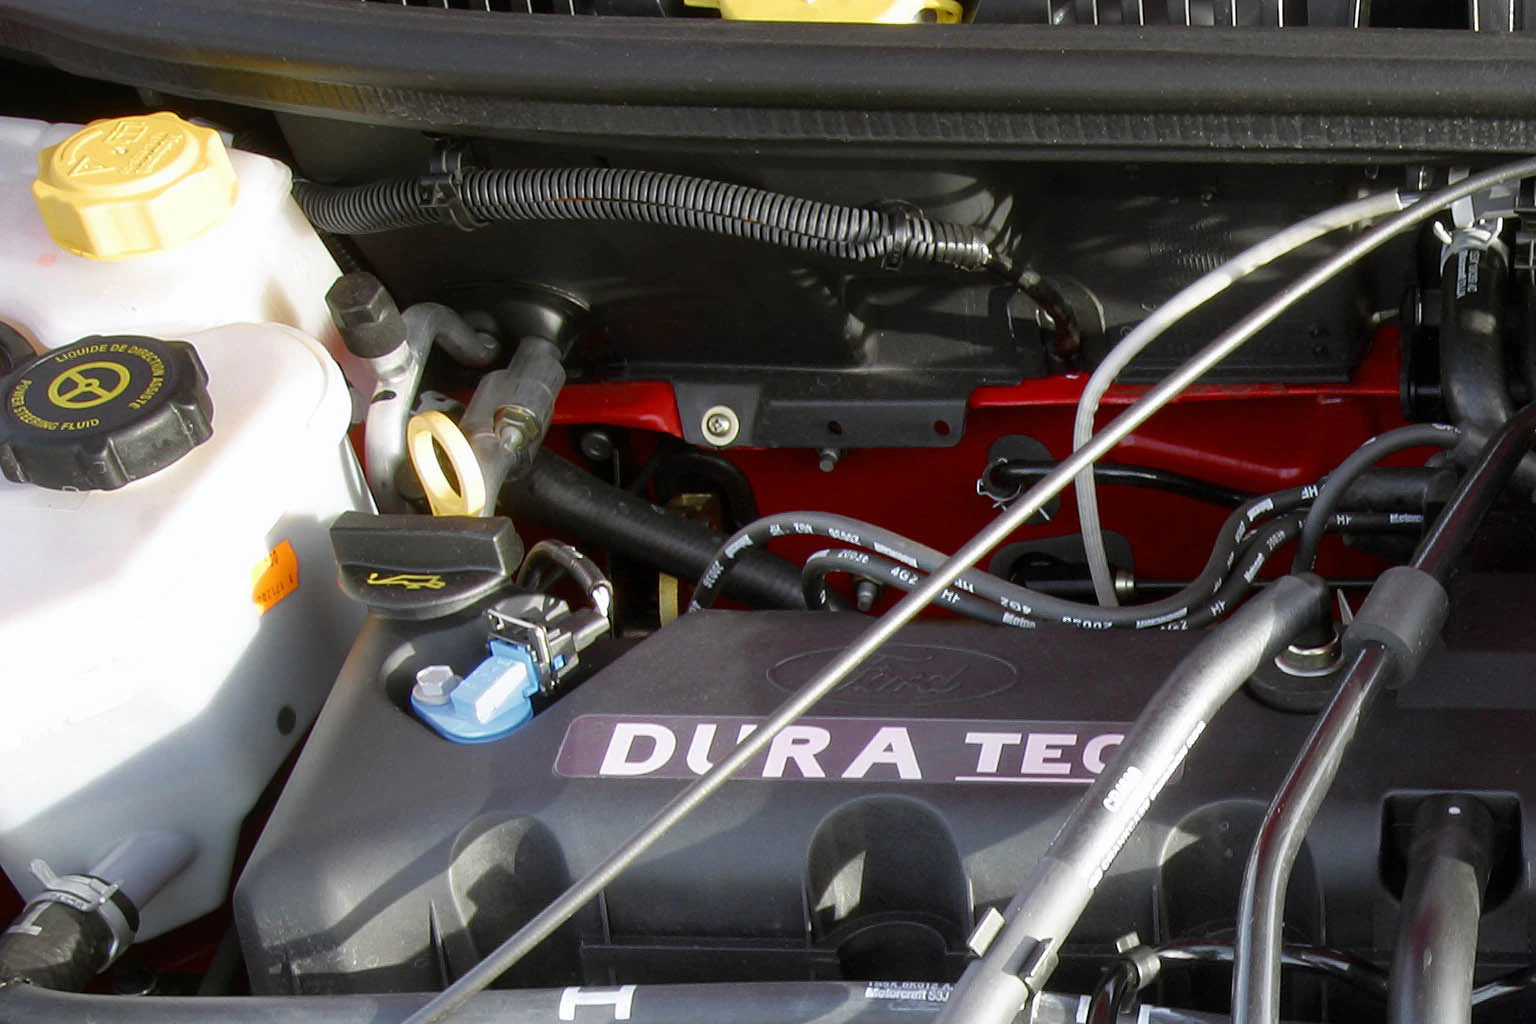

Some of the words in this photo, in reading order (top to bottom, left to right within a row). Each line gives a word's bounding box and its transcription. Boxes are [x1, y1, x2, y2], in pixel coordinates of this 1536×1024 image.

[54, 343, 108, 363] LIQUIDE
[110, 344, 128, 354] DE
[10, 379, 33, 406] POWER
[13, 405, 60, 431] STEERING
[60, 418, 100, 431] FLUID
[600, 723, 923, 779] DURA
